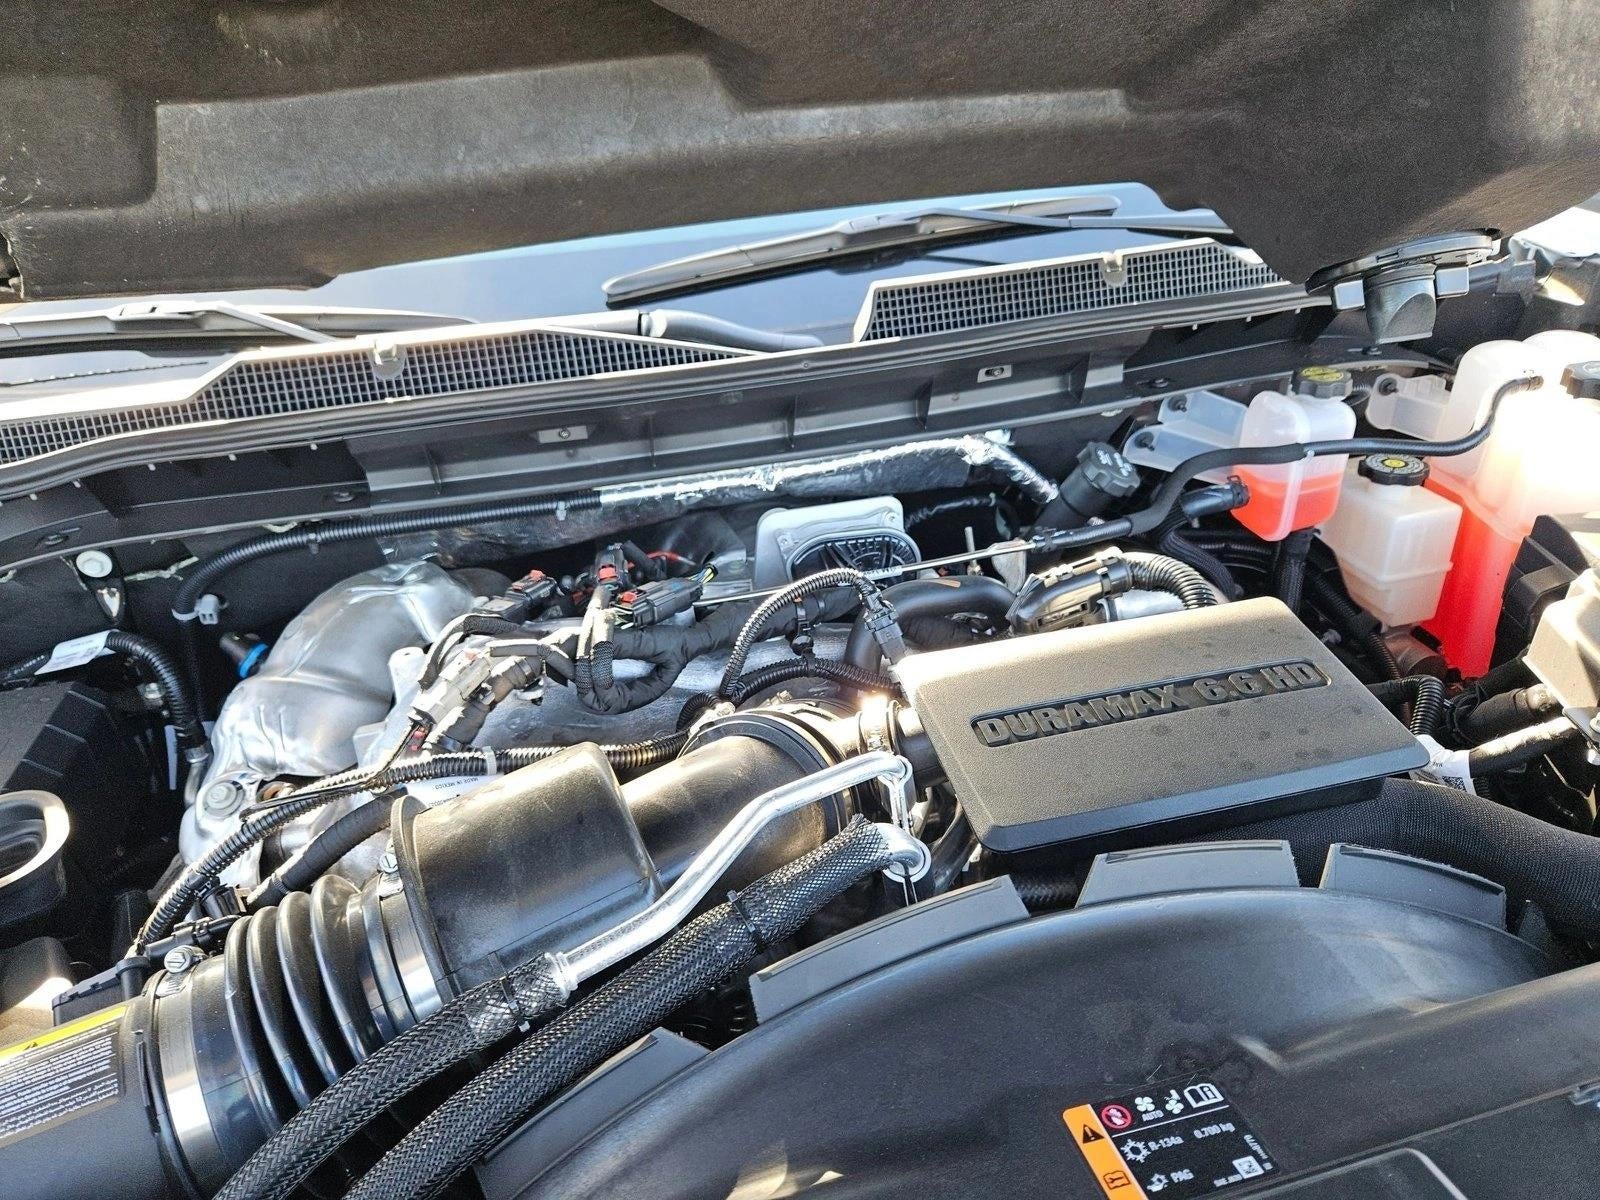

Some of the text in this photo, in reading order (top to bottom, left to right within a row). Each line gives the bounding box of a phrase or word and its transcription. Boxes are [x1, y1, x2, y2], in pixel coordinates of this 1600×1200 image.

[977, 661, 1323, 745] DURAMAX 6.6 HD
[435, 782, 455, 790] MEXICO
[1142, 1110, 1164, 1121] AUTO
[1147, 1122, 1236, 1151] R-134a 0.700 kg
[1170, 1168, 1194, 1183] PAG
